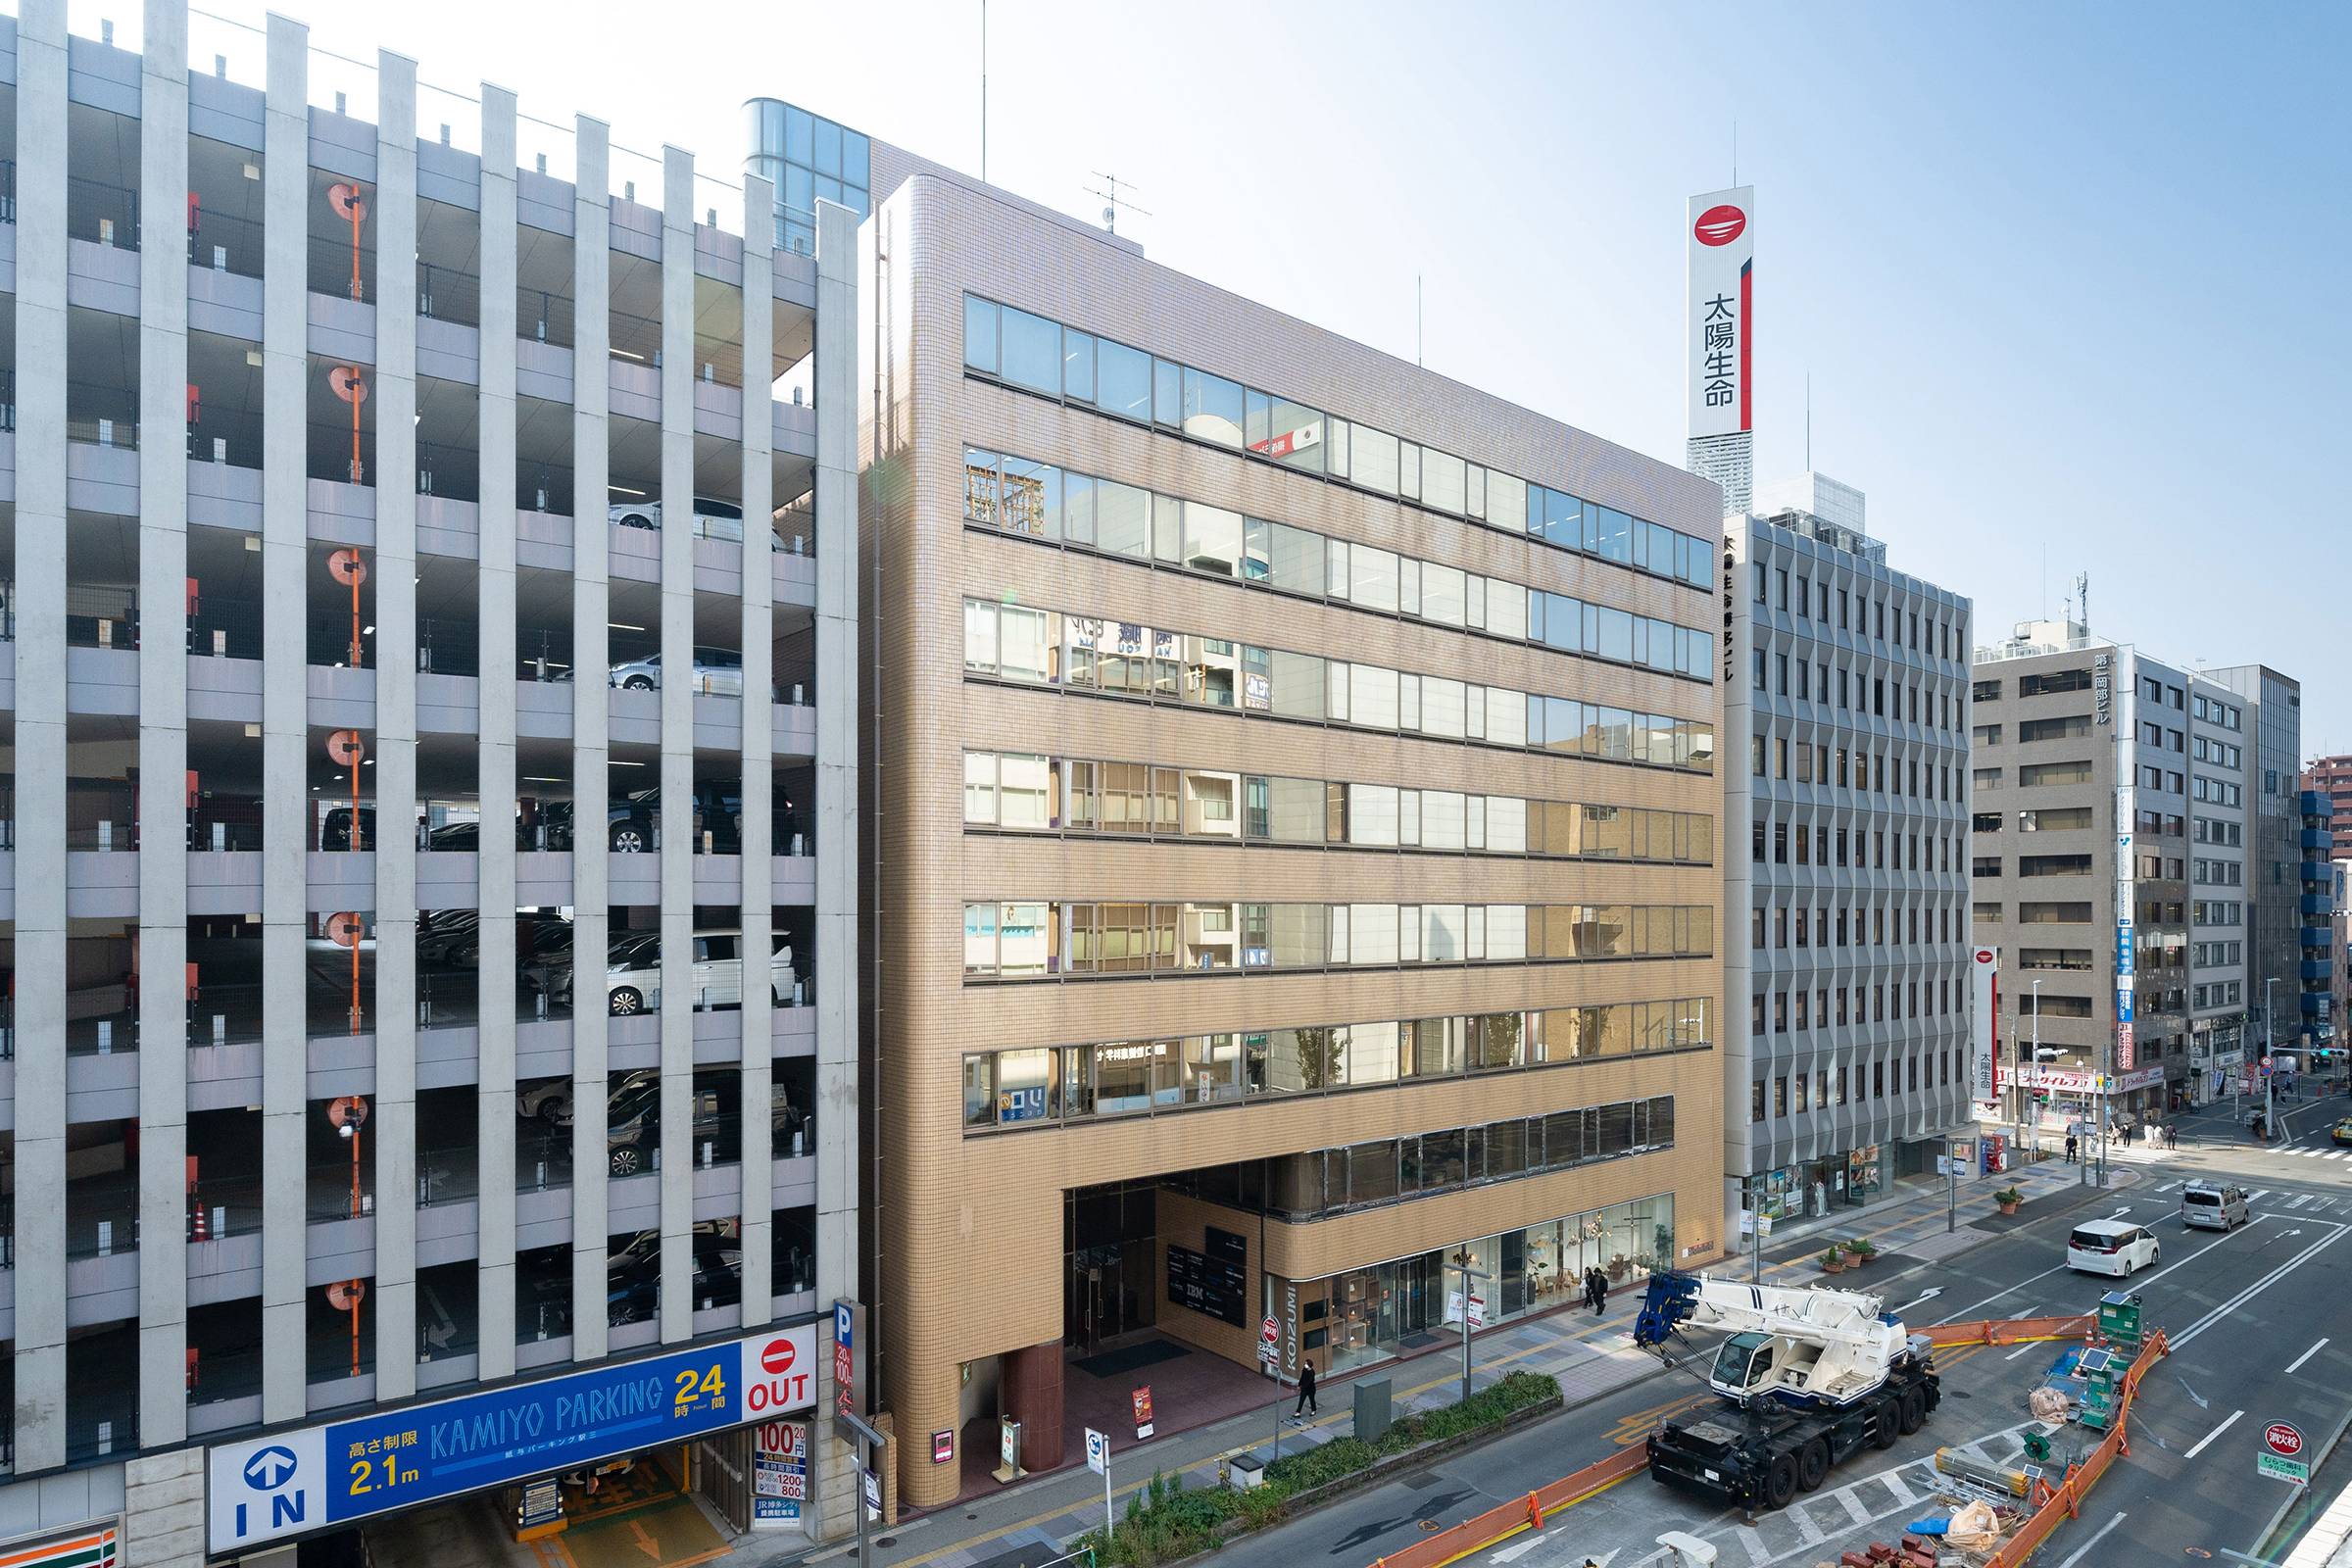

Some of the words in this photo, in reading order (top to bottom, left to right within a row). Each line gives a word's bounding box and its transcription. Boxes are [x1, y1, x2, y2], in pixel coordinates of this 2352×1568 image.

[1704, 292, 1735, 408] 太陽生命
[2095, 654, 2110, 724] 第二岡部ビル
[1980, 1053, 1991, 1089] 太陽生命
[1187, 1284, 1203, 1300] IBM
[838, 1305, 851, 1343] P
[1287, 1286, 1297, 1371] KOIZUMI
[675, 1363, 725, 1405] 24
[748, 1373, 808, 1412] OUT
[431, 1402, 545, 1460] KAMIYO
[557, 1377, 663, 1431] PARKING
[2269, 1431, 2298, 1448] 消火栓
[349, 1430, 418, 1459] 高さ制限
[349, 1454, 419, 1496] 2.1m
[236, 1490, 306, 1539] IN
